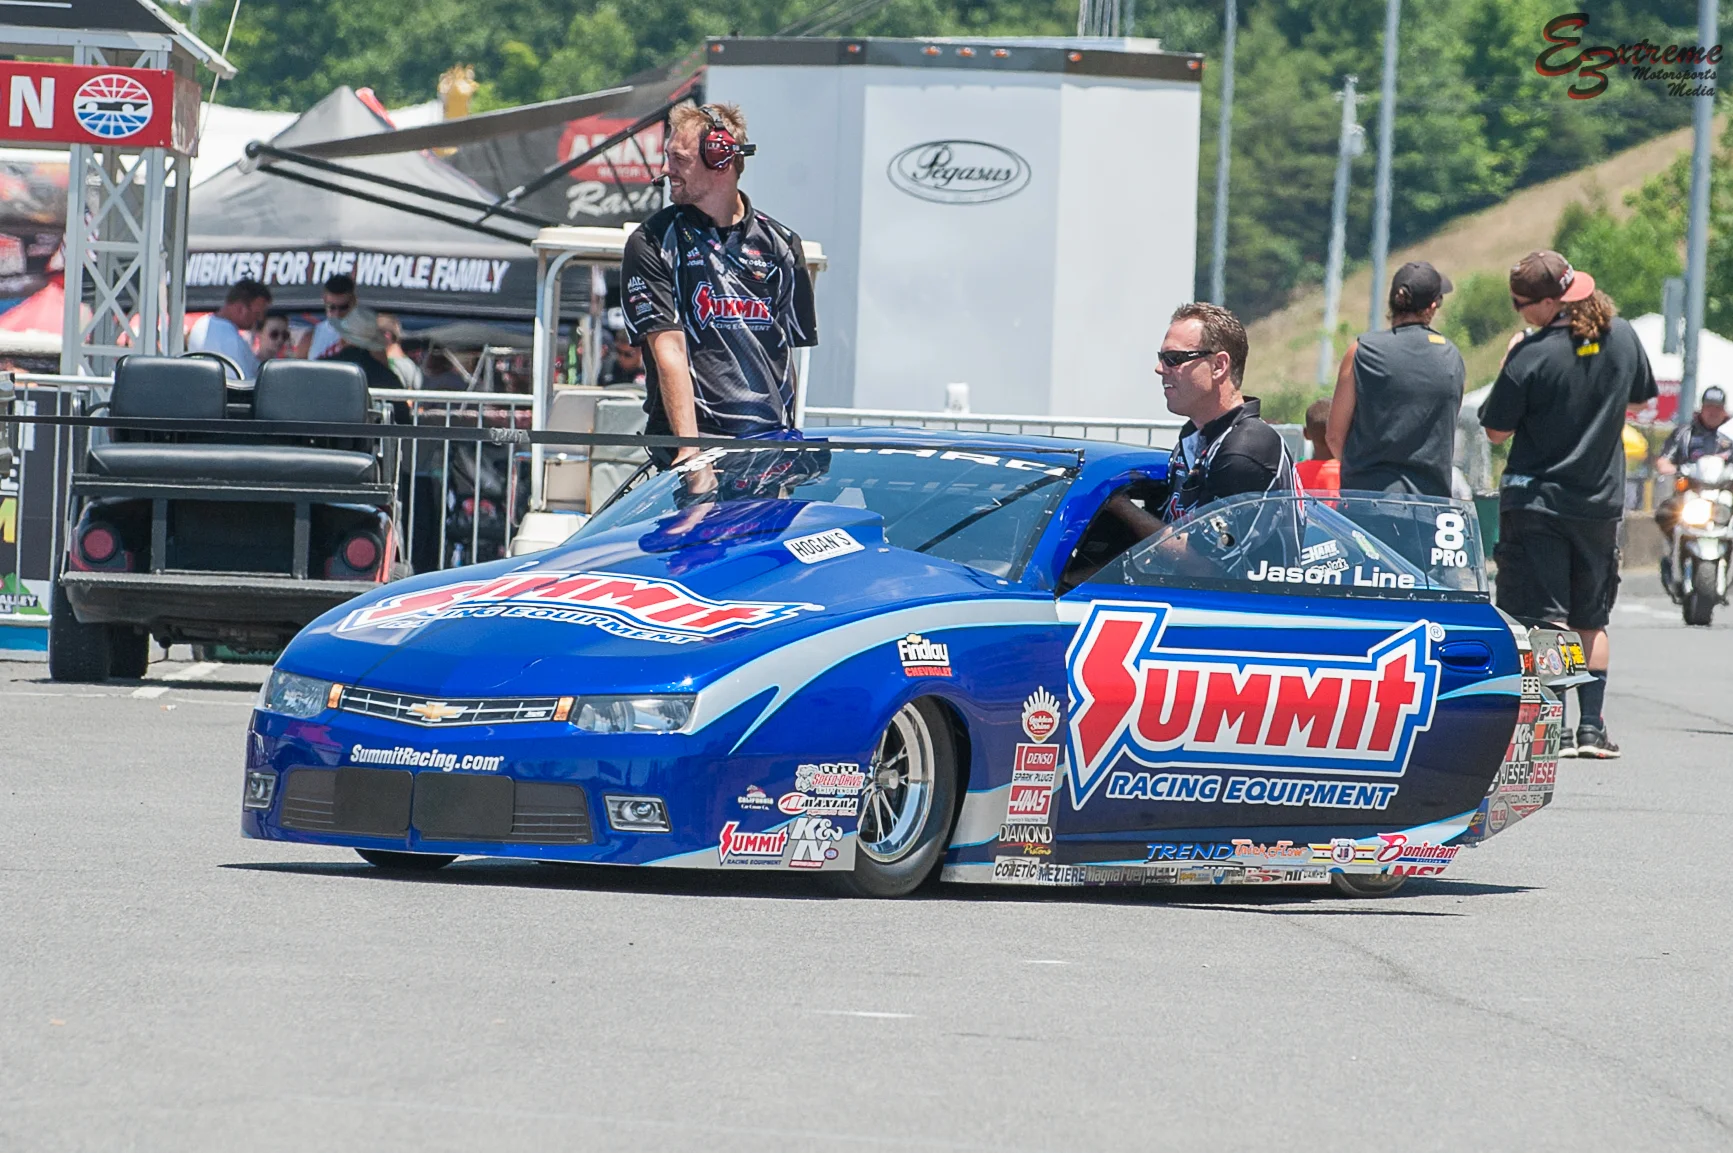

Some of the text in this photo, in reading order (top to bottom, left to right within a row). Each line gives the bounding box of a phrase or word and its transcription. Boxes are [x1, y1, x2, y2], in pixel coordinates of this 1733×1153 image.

[912, 144, 1012, 187] Pegasus
[264, 251, 309, 285] FOR
[355, 252, 433, 290] WHOLE
[430, 256, 511, 294] FAMILY
[1434, 512, 1465, 550] 8
[790, 531, 851, 557] HOGAN'S
[1431, 548, 1468, 569] PRO
[1248, 560, 1342, 586] Jason
[1354, 566, 1416, 589] Line
[500, 606, 704, 645] EQUIPMENT
[897, 638, 950, 667] Findlay
[350, 743, 502, 773] SummitRacing.com
[1026, 752, 1054, 765] DENSO
[1013, 772, 1055, 782] SPARK PLUGS
[1501, 763, 1528, 785] JESEL
[1529, 762, 1556, 784] JESEL
[1106, 772, 1400, 810] RACING EQUIPMENT
[801, 798, 858, 809] MAXIMA
[999, 825, 1053, 844] DIAMOND
[1147, 842, 1234, 861] TREND
[1039, 865, 1085, 882] MEZIERE
